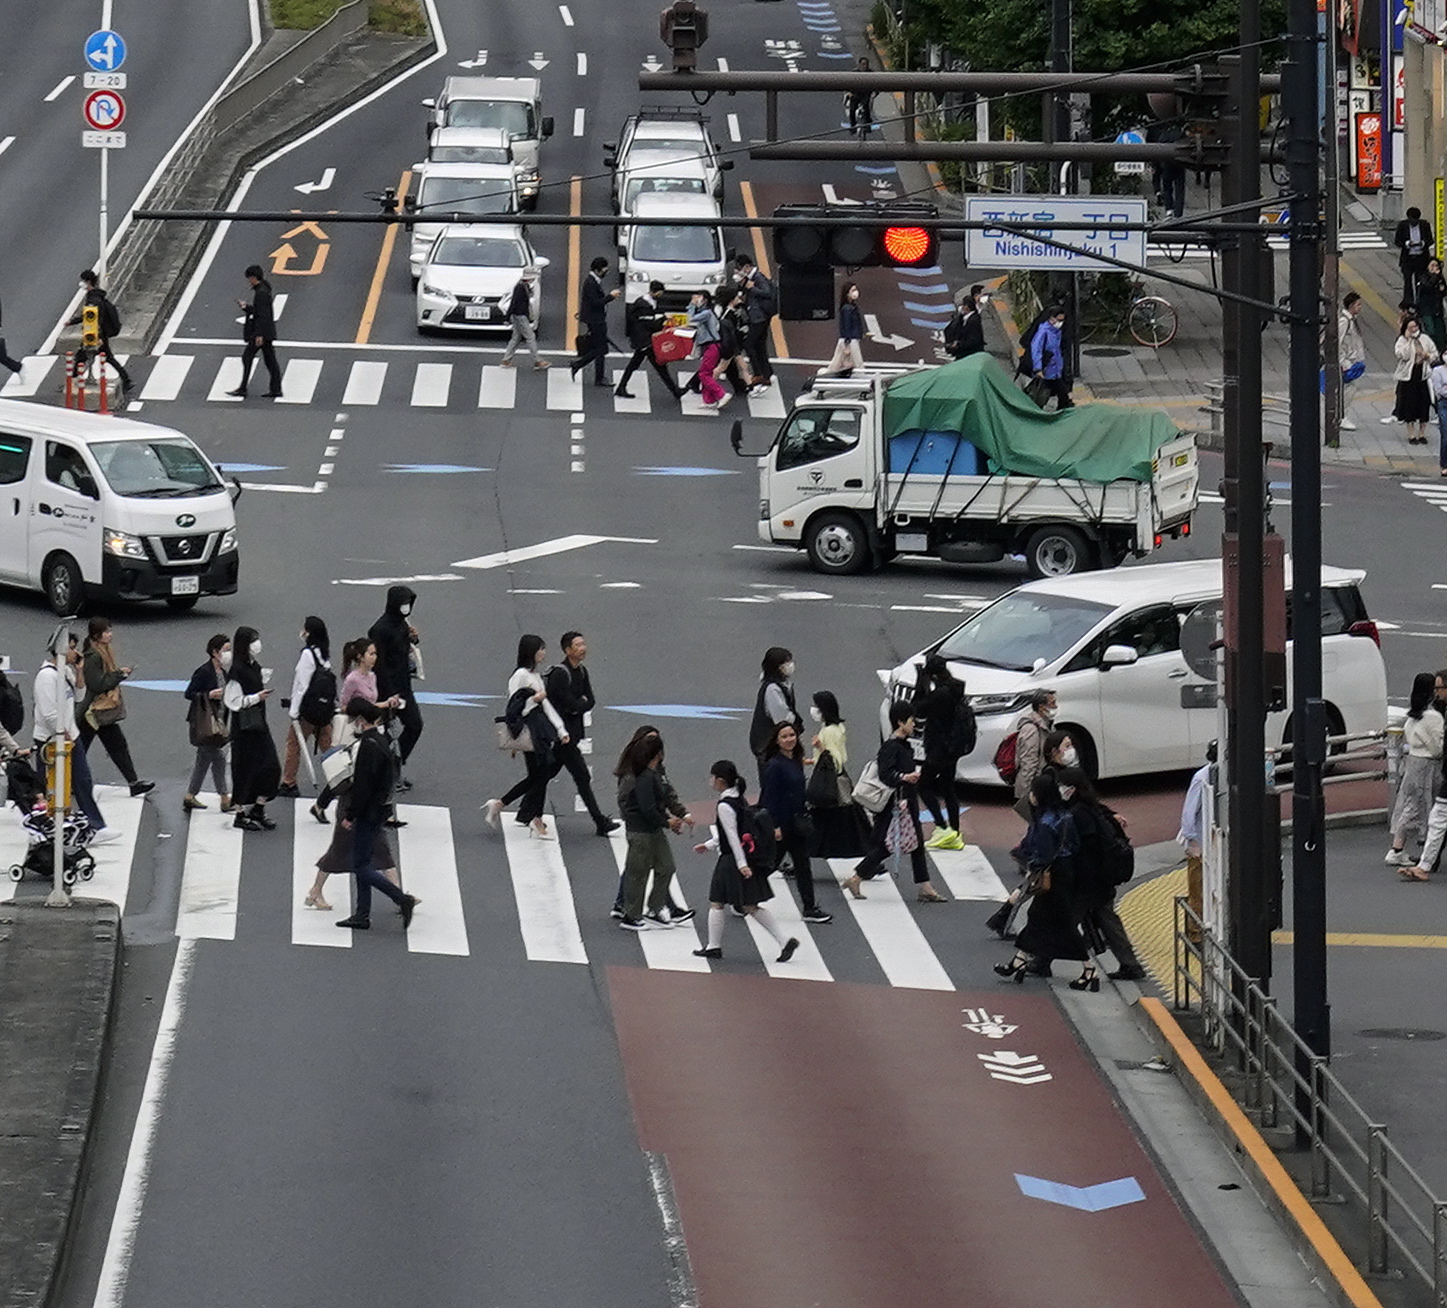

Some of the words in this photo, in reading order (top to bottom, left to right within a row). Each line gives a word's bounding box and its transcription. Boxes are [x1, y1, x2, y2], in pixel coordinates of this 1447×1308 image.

[89, 74, 122, 86] 7-20
[86, 133, 123, 146] ここまで
[982, 210, 1130, 242] 西新宿丁目
